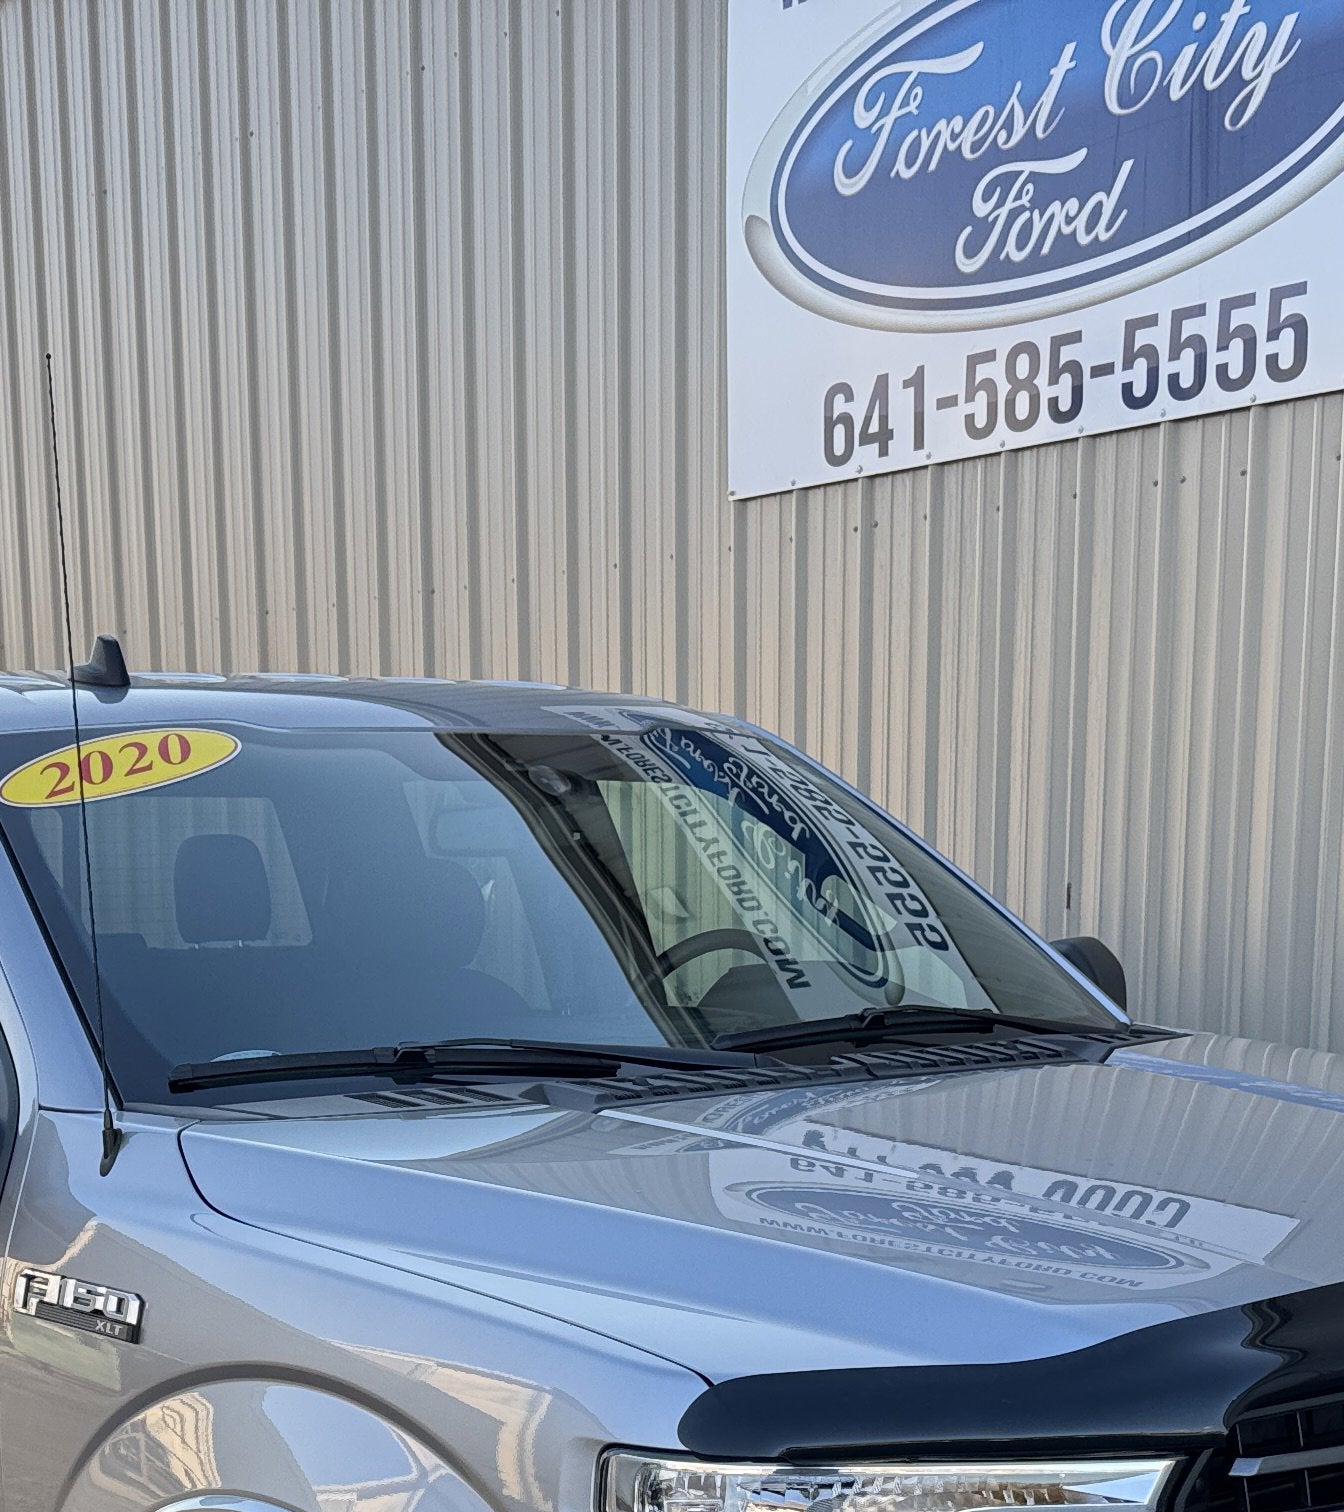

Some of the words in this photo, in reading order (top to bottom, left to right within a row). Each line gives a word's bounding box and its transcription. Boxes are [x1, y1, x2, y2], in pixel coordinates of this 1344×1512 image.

[833, 40, 1077, 196] Forest
[1100, 0, 1301, 131] City
[955, 147, 1135, 274] Ford
[823, 281, 1309, 467] 641-585-5555
[40, 733, 192, 799] 2020
[96, 1319, 123, 1336] XLT
